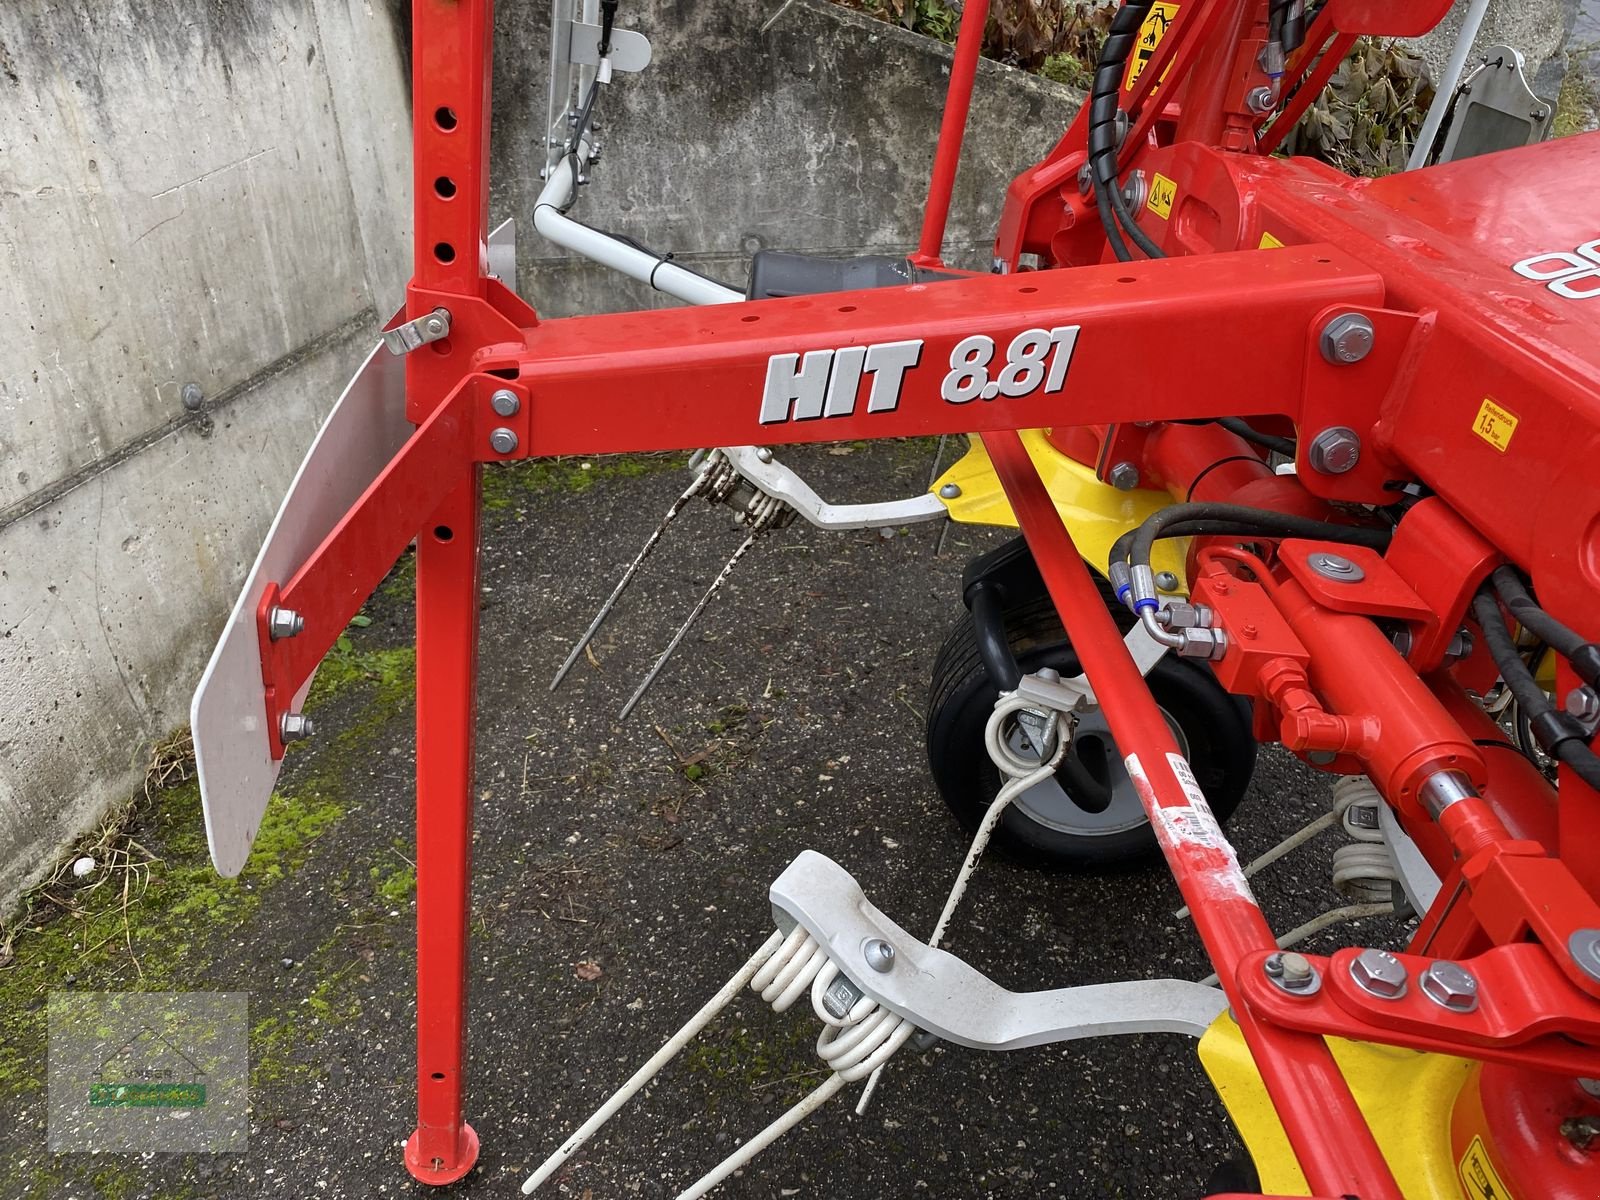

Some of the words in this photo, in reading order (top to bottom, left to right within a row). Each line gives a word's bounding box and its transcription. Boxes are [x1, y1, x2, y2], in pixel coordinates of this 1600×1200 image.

[759, 339, 924, 424] HIT
[941, 325, 1081, 403] 8.81
[1480, 413, 1495, 434] 1,5
[1484, 403, 1513, 427] Reifendruck
